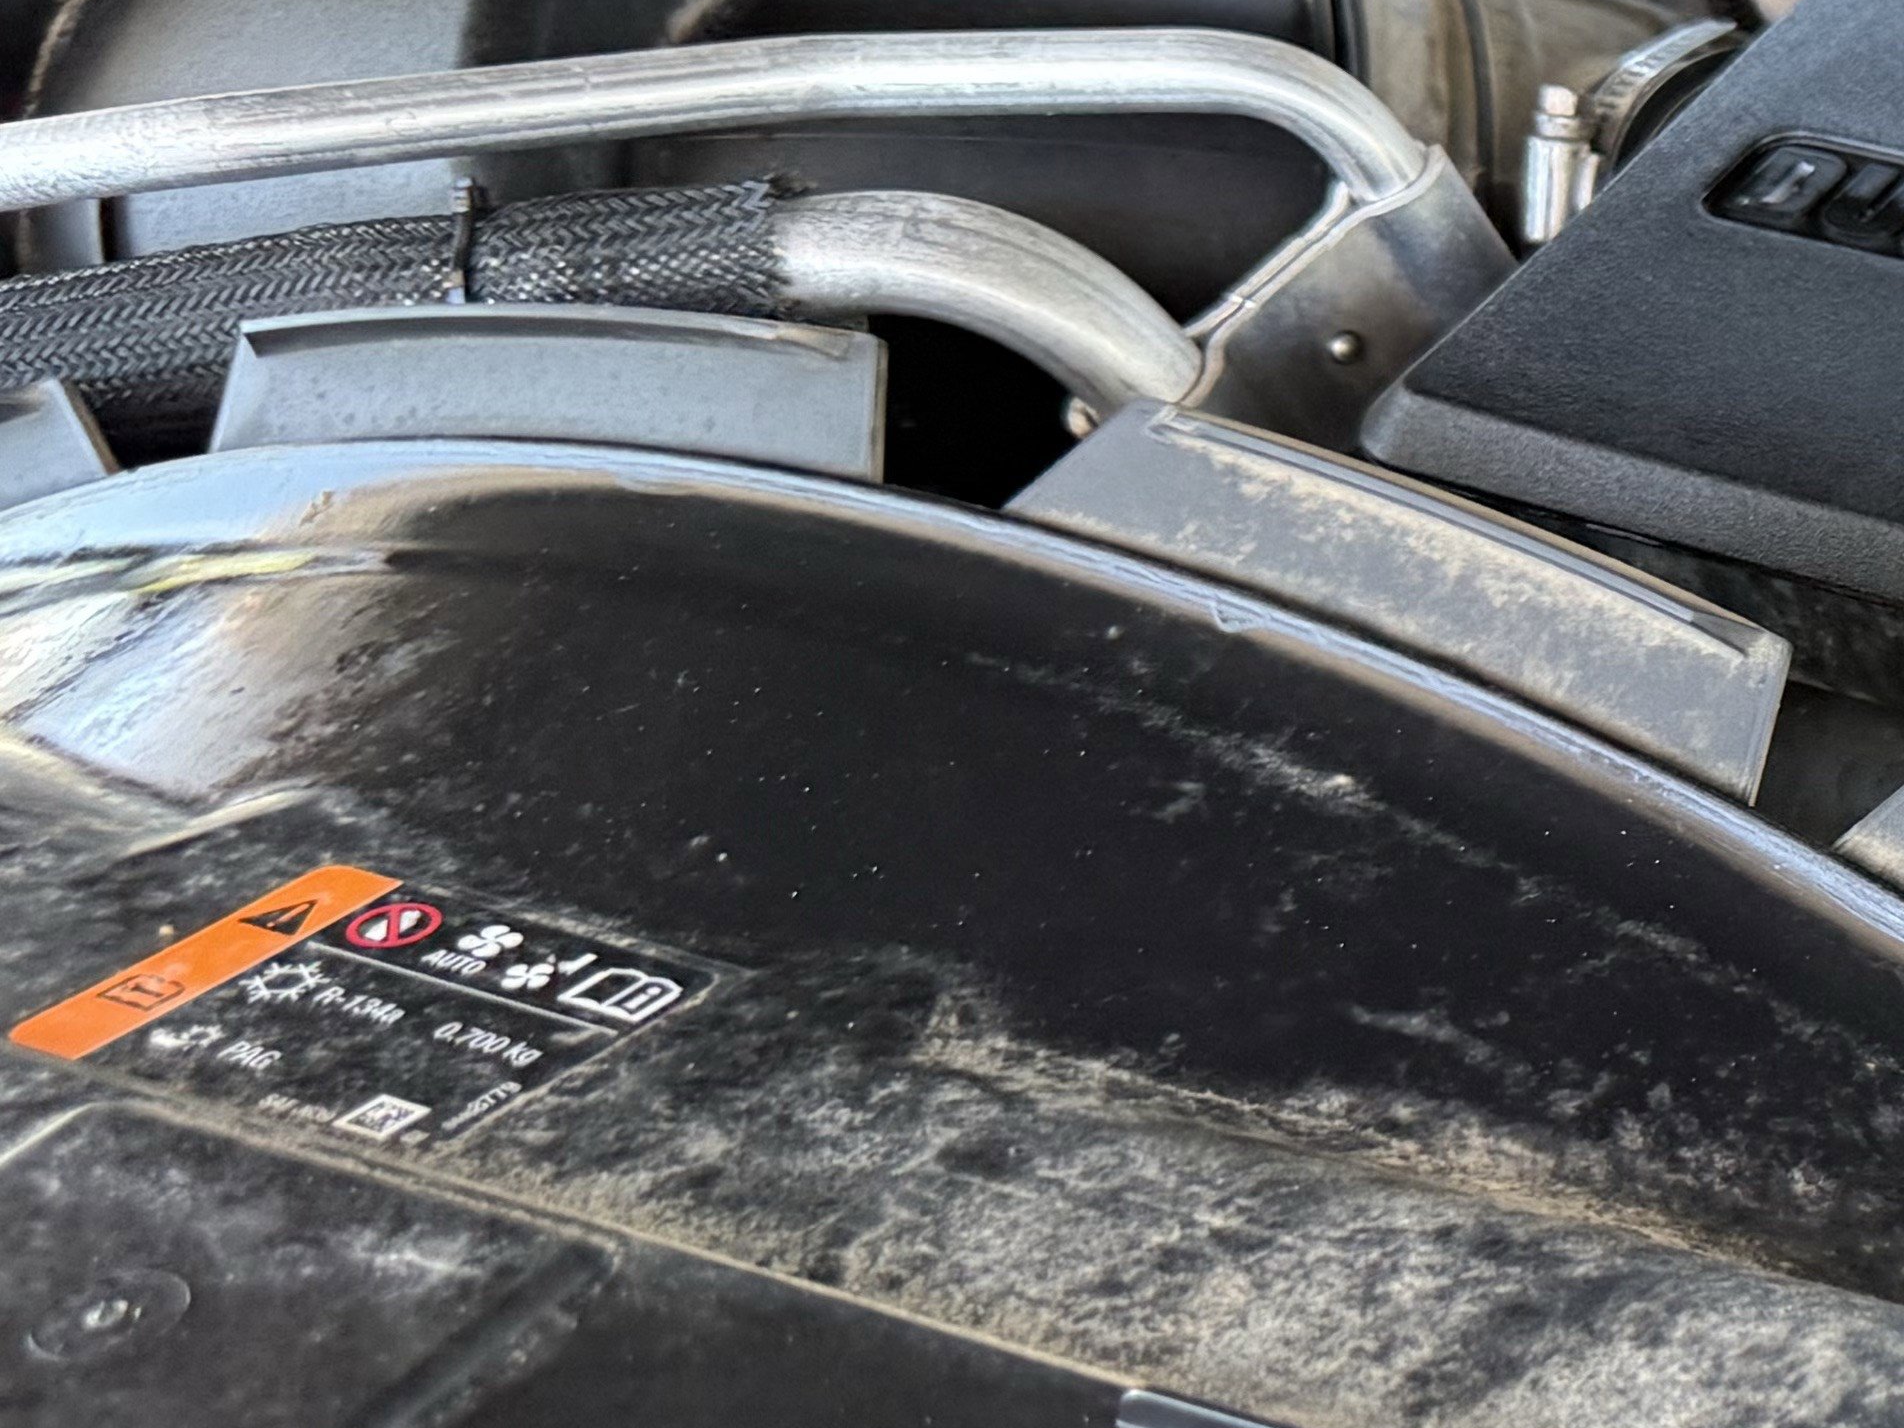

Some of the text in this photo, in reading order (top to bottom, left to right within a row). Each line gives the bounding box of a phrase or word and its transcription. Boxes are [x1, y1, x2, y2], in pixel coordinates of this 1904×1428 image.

[422, 948, 486, 974] AUTO
[316, 983, 541, 1068] R-134a 0.700 kg
[225, 1039, 284, 1070] PAG
